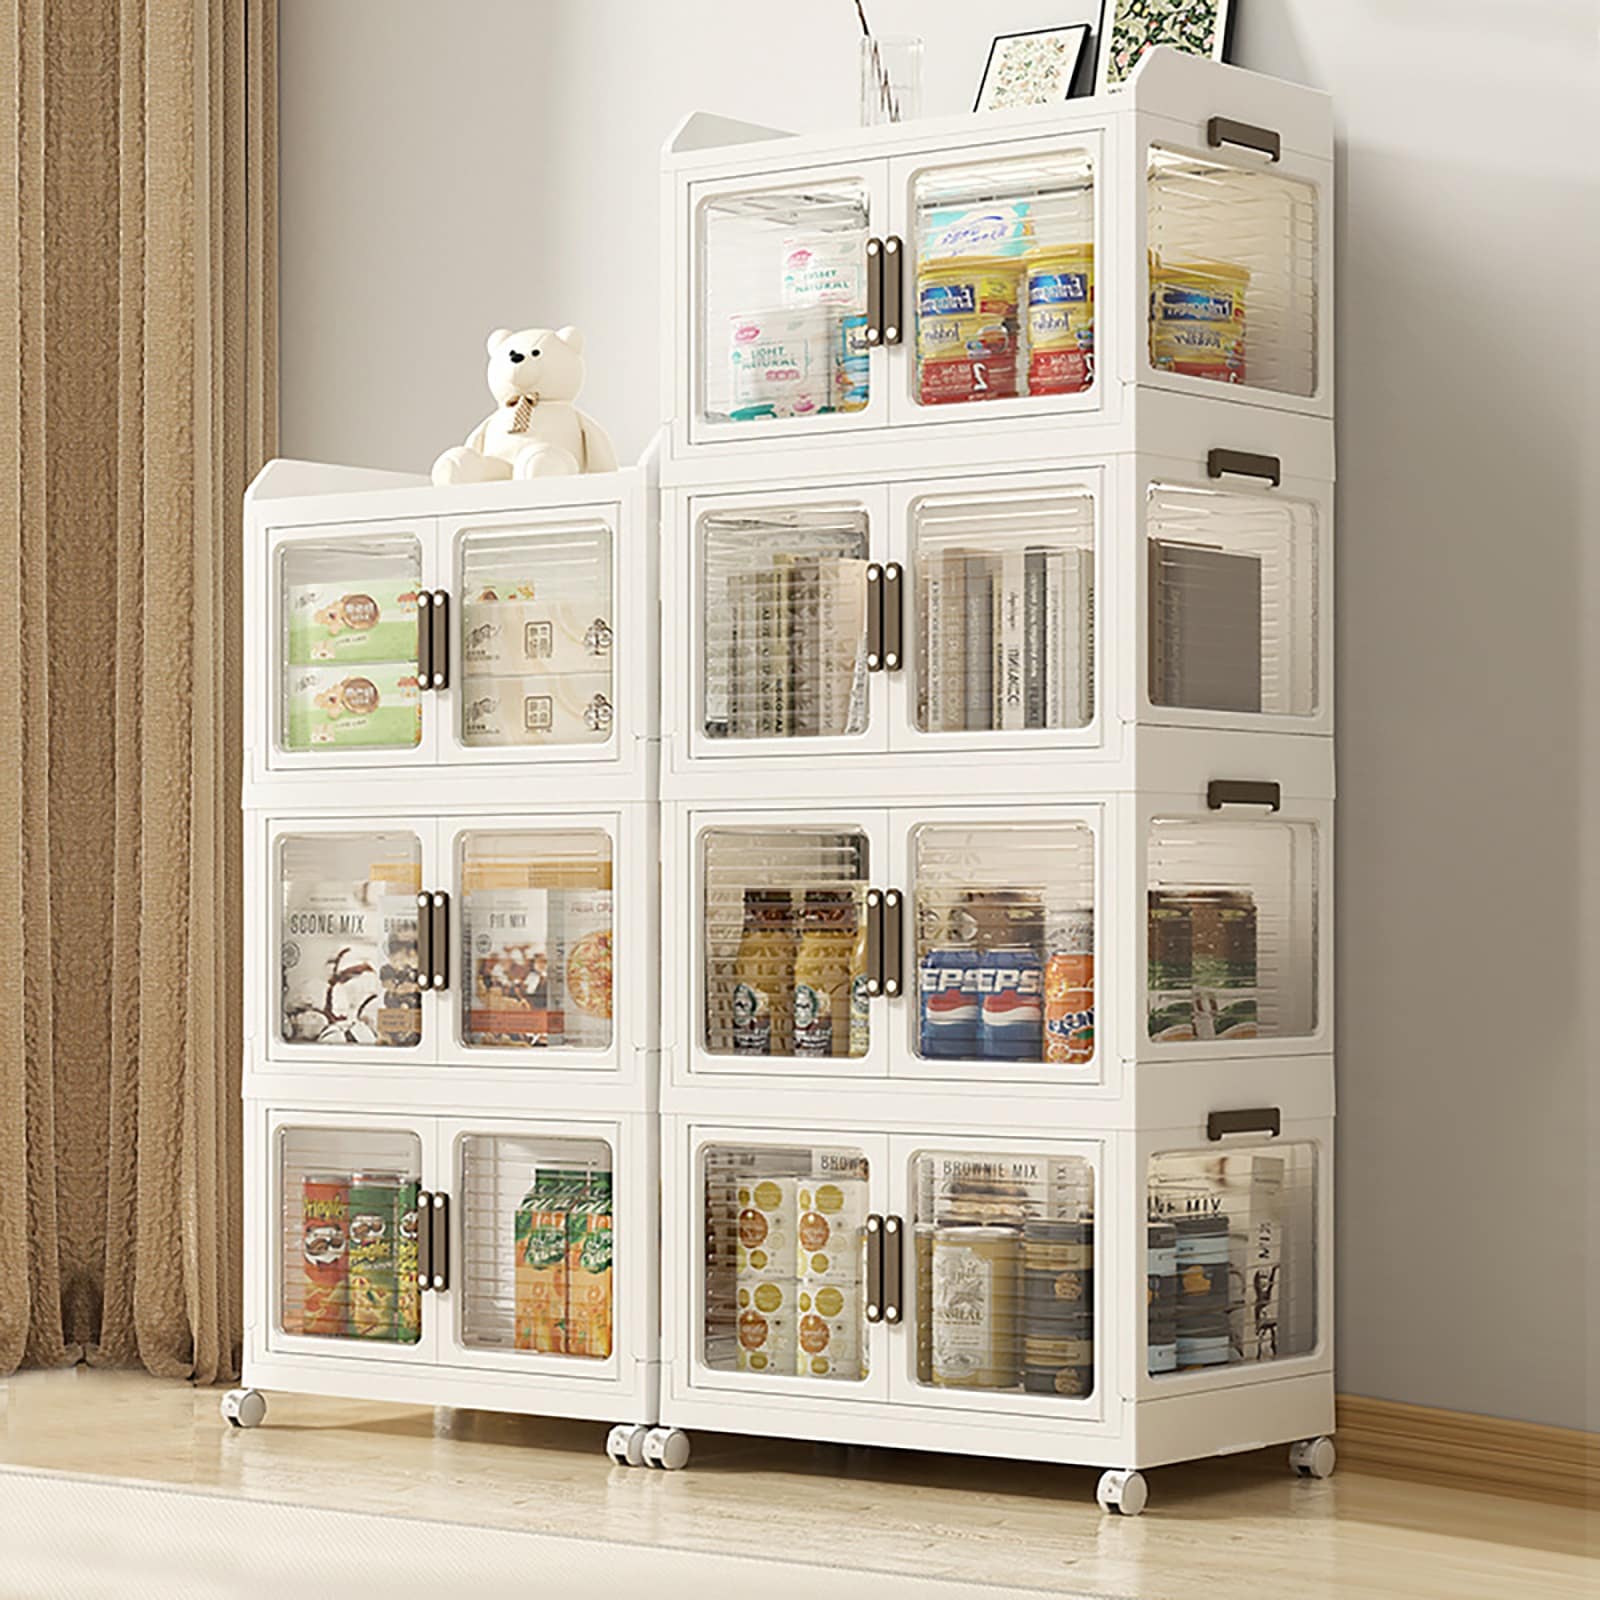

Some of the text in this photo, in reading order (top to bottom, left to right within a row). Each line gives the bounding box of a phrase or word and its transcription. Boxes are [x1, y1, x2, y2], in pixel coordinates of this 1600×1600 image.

[751, 346, 784, 359] LIGHT
[290, 914, 366, 934] SCONE MIX
[943, 1160, 1038, 1179] BROWNIE MIX
